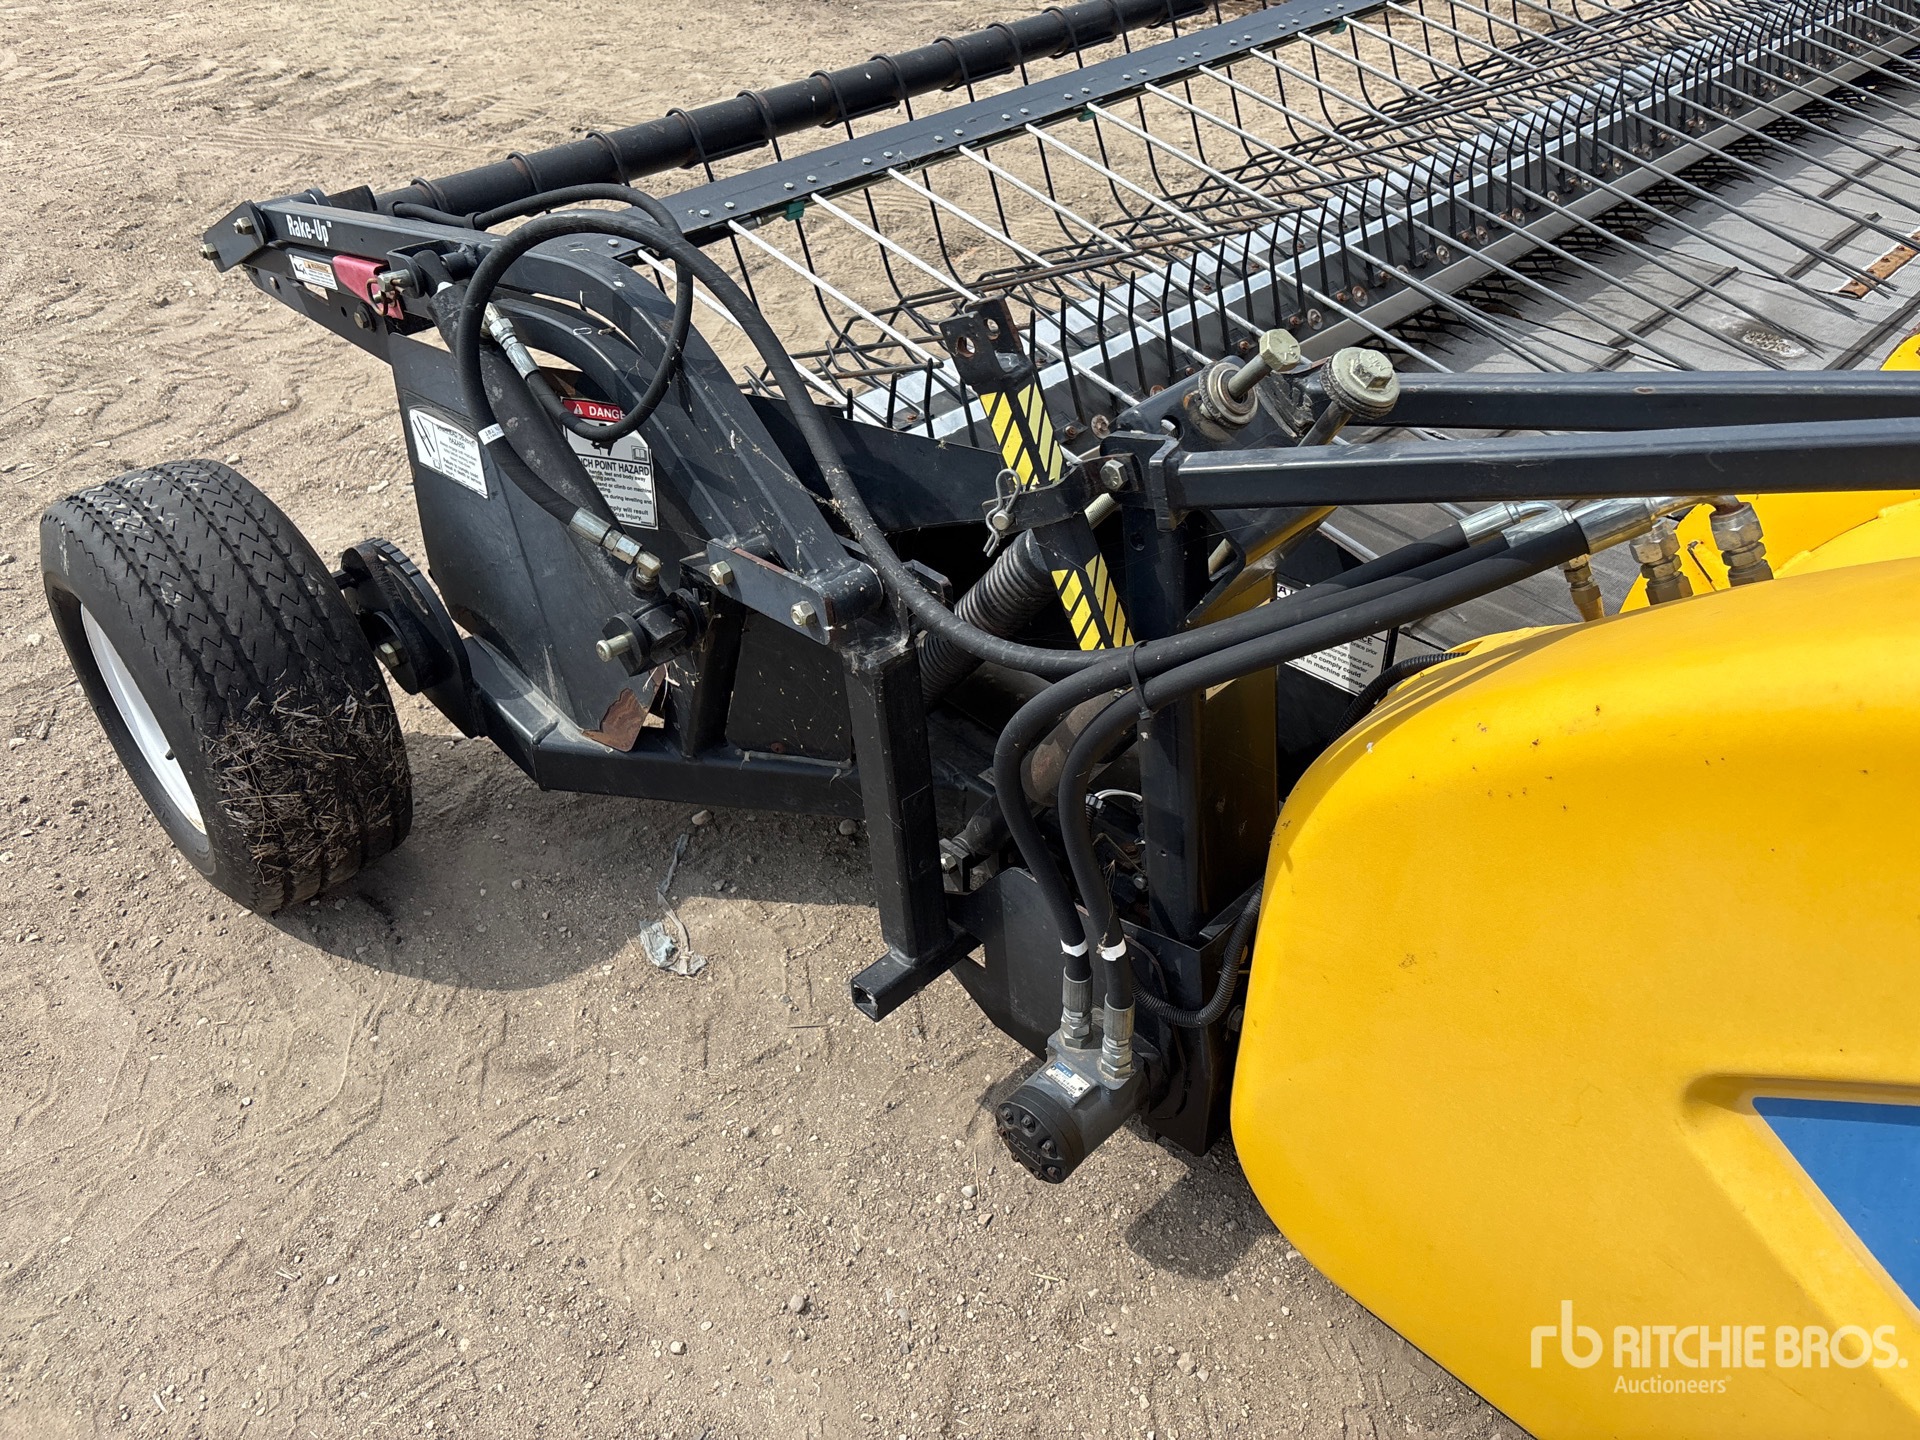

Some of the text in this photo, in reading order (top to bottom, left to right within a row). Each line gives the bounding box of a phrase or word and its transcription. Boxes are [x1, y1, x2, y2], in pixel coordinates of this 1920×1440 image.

[285, 214, 329, 247] Rake-Up
[589, 406, 627, 420] DANGE
[595, 460, 617, 471] POINT
[618, 463, 650, 476] HAZARD
[1313, 661, 1341, 677] machine
[1319, 656, 1342, 670] comply
[1343, 667, 1361, 678] could
